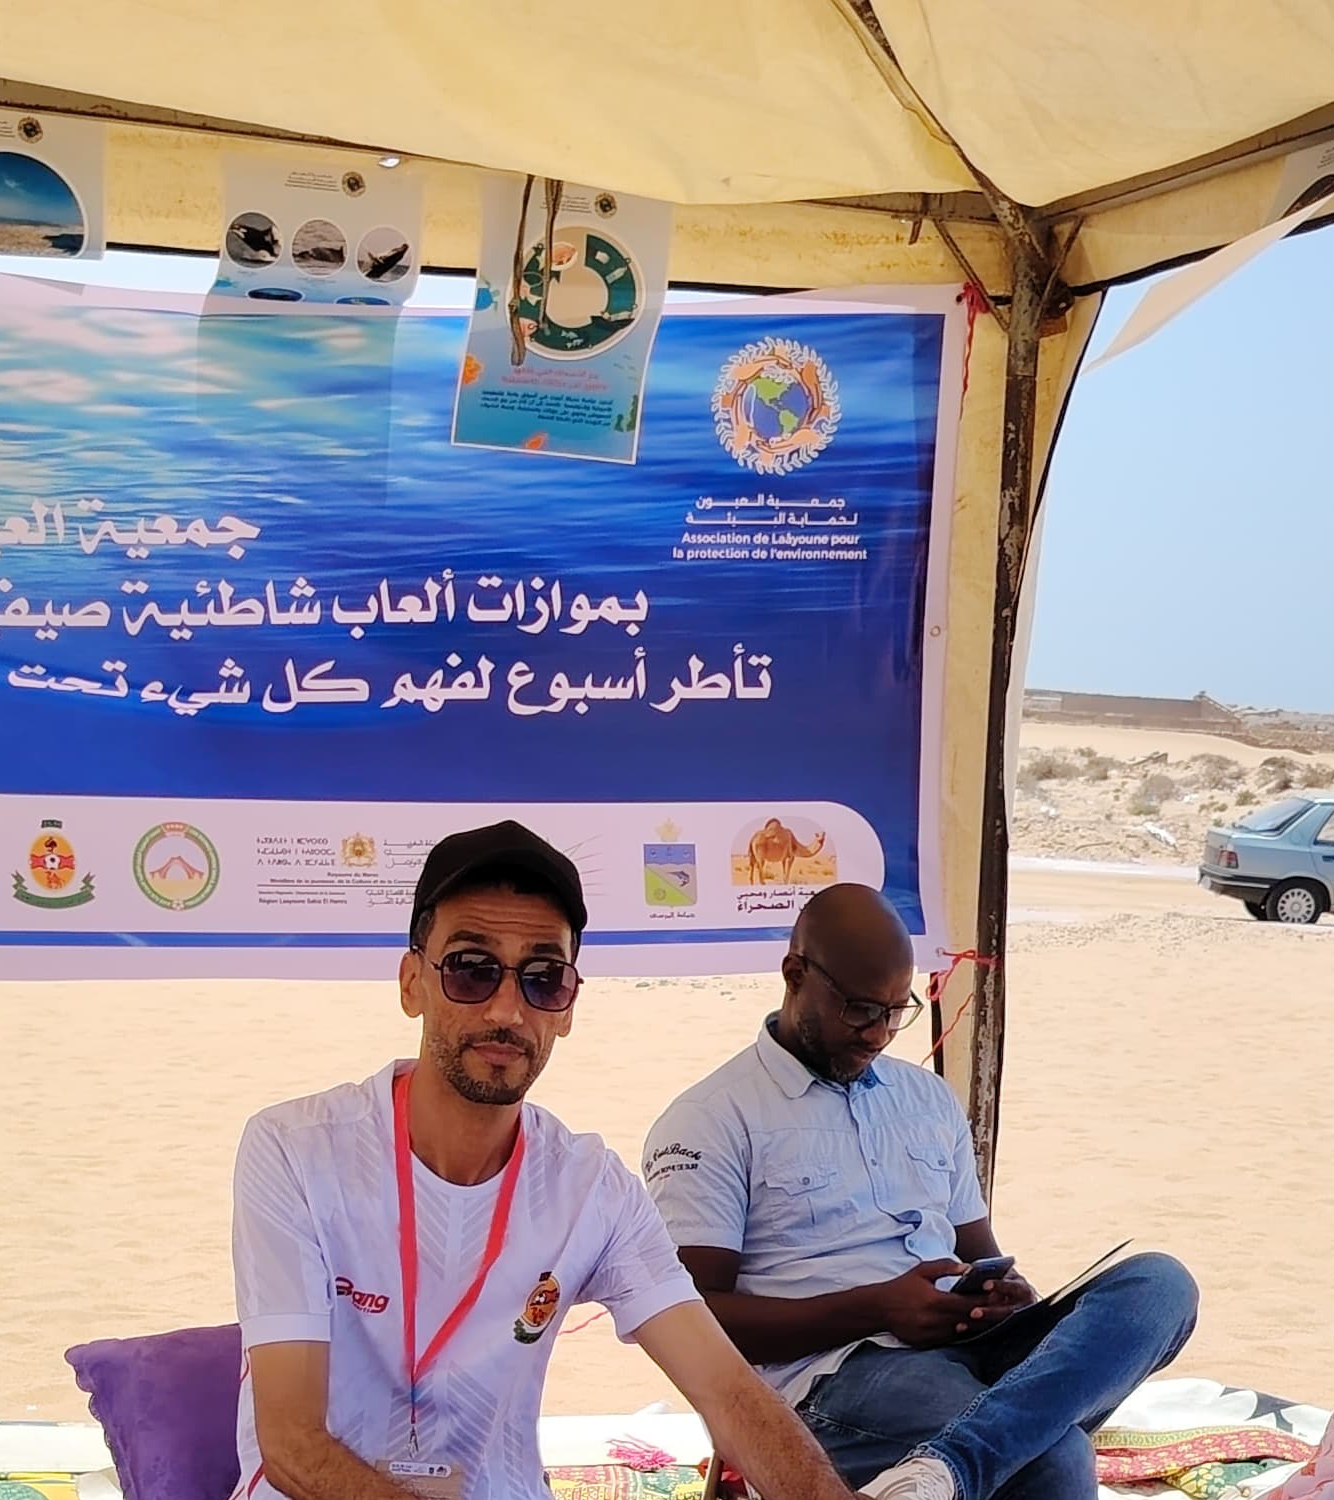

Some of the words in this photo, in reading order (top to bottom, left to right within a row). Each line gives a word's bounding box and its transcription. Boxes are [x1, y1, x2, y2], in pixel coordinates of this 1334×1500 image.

[77, 498, 261, 560] جمعية
[672, 547, 684, 559] la
[686, 548, 750, 560] protection
[751, 548, 768, 560] de
[770, 548, 867, 560] l'environnement
[681, 532, 751, 544] Association
[753, 532, 769, 544] de
[831, 535, 860, 546] pour
[122, 576, 320, 641] شاطئية
[332, 569, 455, 641] ألعاب
[468, 574, 649, 636] بموازات
[9, 659, 128, 699] تحت
[141, 658, 252, 715] شيء
[262, 658, 370, 712] كل
[380, 652, 494, 712] لفهم
[508, 647, 646, 715] أسبوع
[651, 644, 772, 712] تأطر
